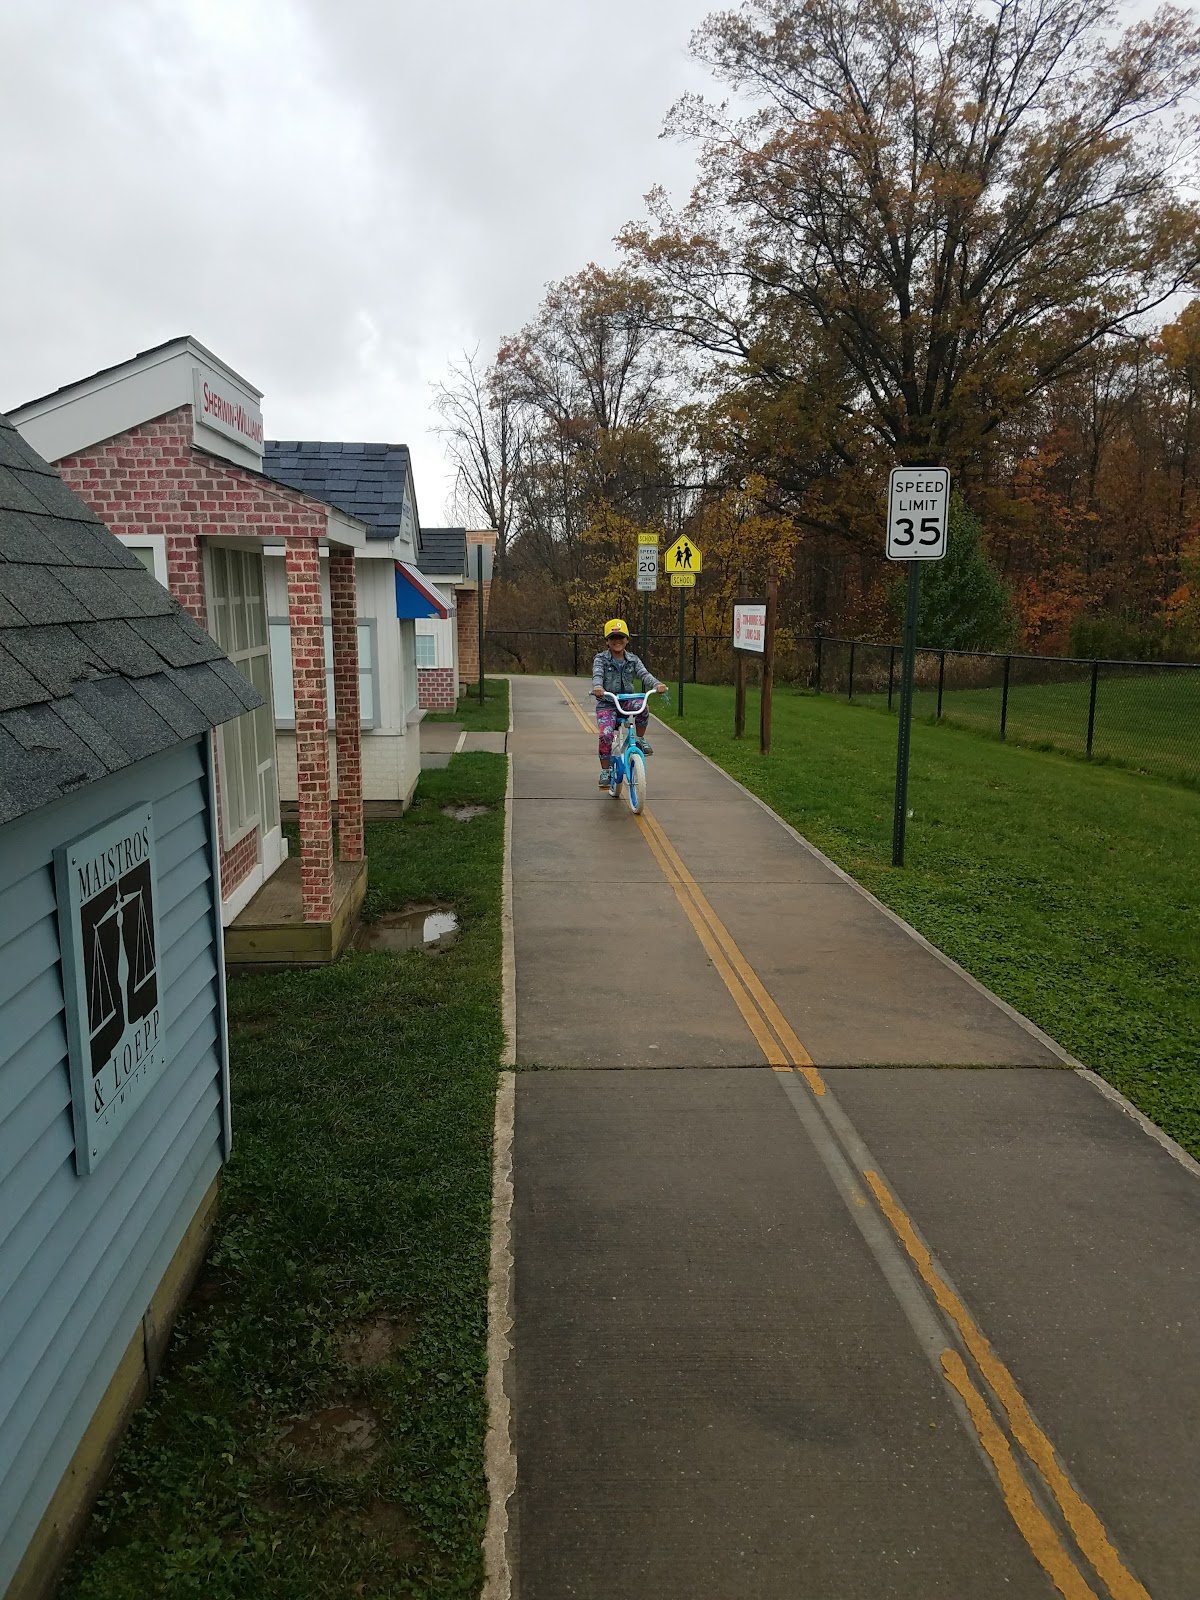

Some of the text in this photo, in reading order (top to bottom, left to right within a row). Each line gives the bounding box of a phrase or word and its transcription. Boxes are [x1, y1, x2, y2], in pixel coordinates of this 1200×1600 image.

[895, 481, 944, 493] SPEED
[899, 499, 938, 511] LIMIT
[892, 517, 941, 546] 35
[639, 535, 657, 543] SCHOOL
[639, 561, 656, 572] 20
[673, 576, 694, 585] SCHOOL
[78, 826, 149, 903] MAISTROS
[94, 1009, 160, 1114] & LOEPP
[104, 1054, 155, 1125] LIMITED
